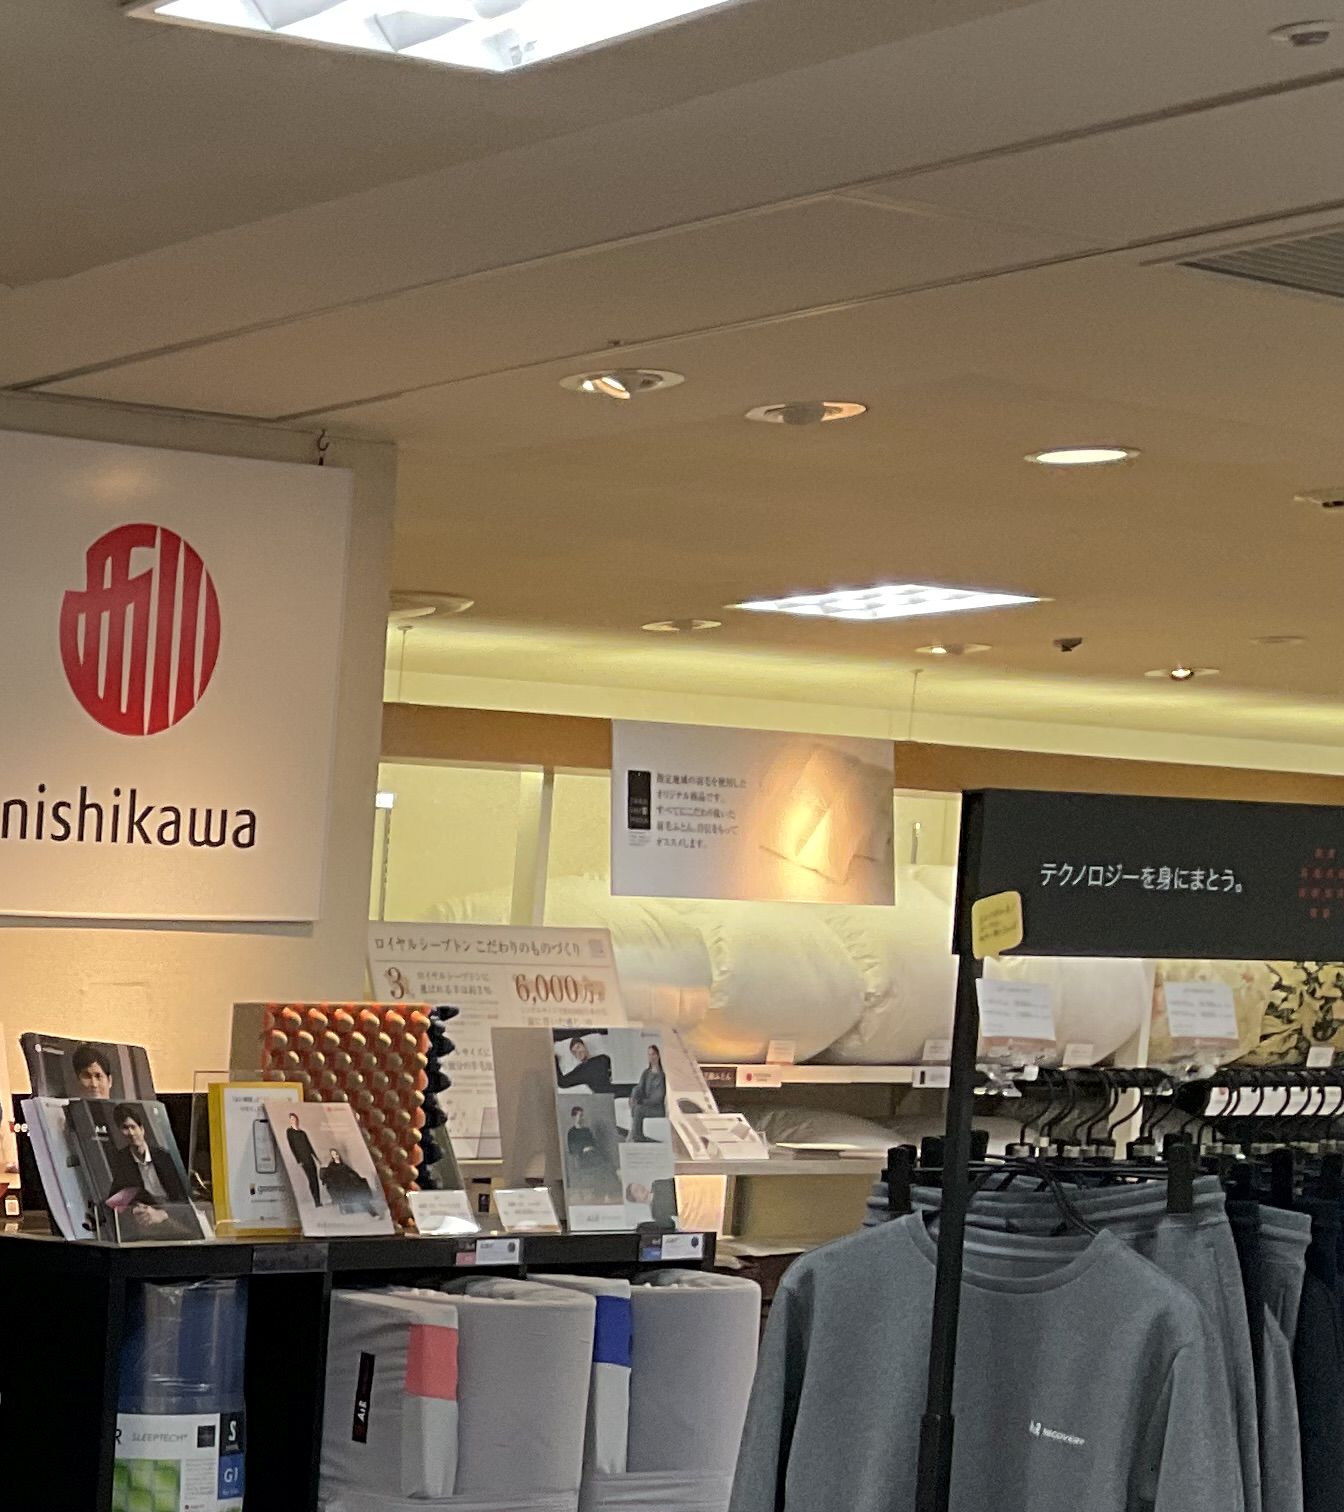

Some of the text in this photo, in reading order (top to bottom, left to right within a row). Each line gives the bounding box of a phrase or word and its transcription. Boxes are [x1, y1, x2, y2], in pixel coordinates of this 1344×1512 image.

[0, 783, 257, 849] nishikawa
[1040, 862, 1243, 894] テクノロジーを身にまとう。
